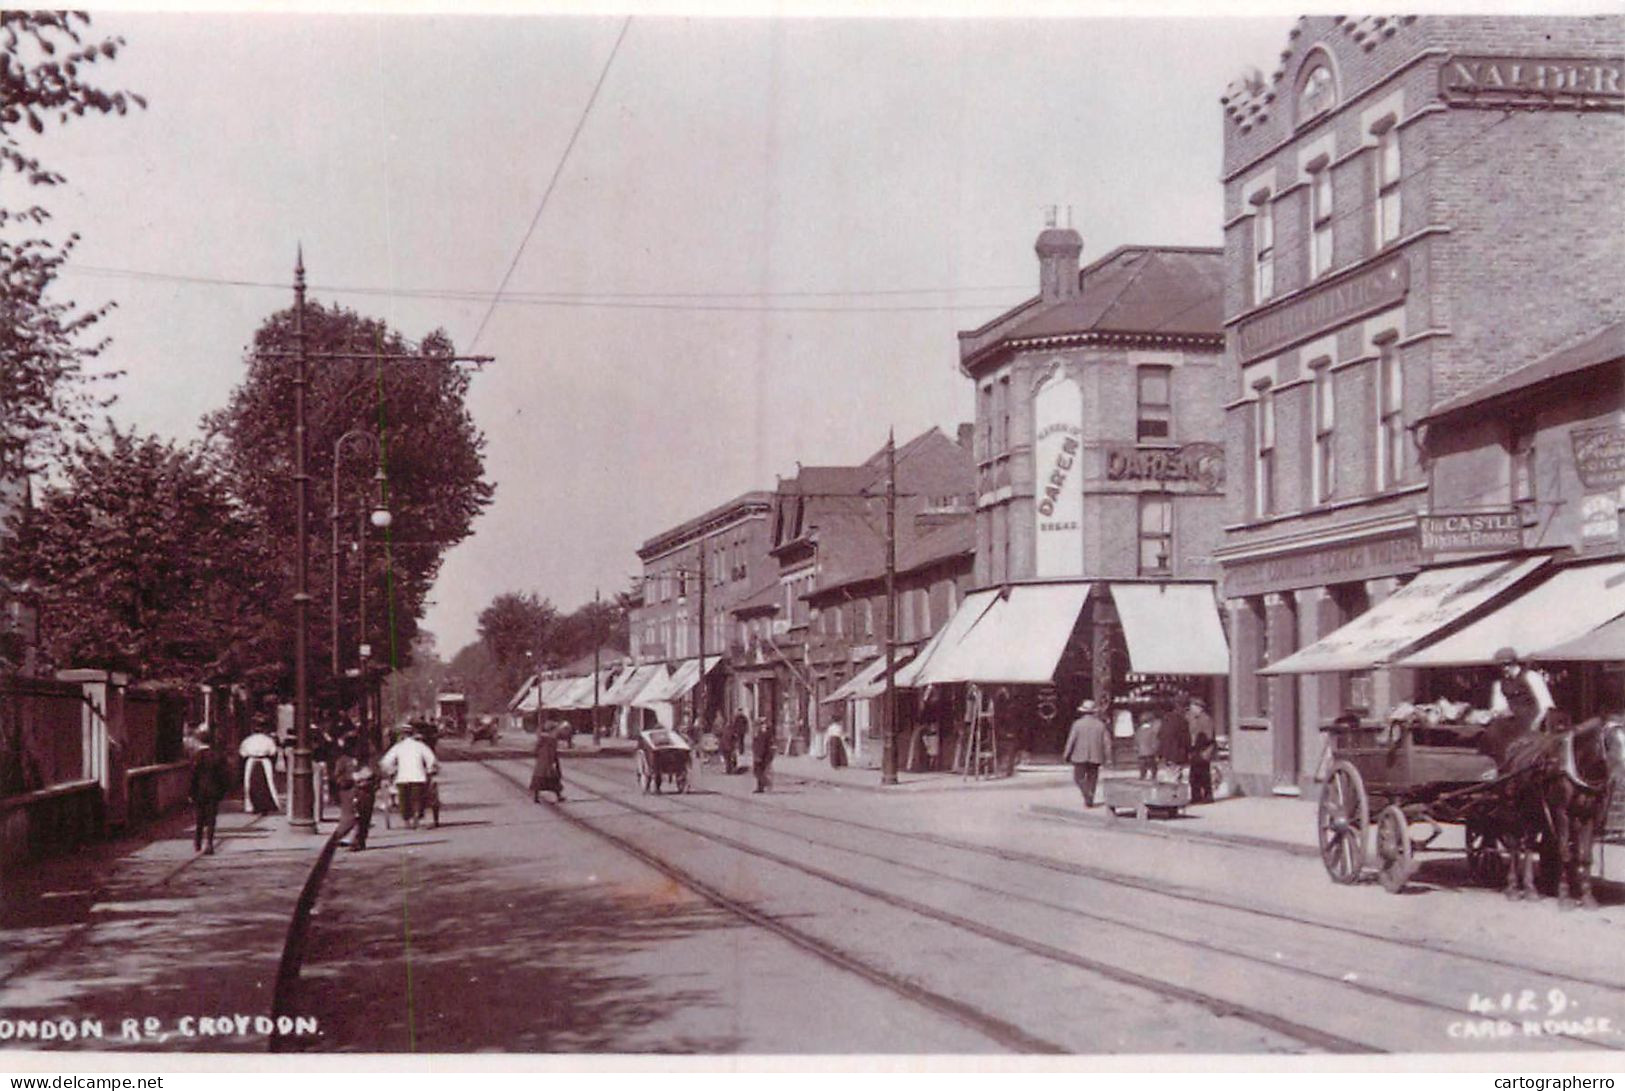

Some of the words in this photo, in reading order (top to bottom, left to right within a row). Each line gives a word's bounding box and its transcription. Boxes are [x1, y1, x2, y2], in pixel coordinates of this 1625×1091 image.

[1038, 437, 1079, 517] DAREN
[1107, 450, 1196, 480] DAREN
[1040, 522, 1077, 531] BREAD
[1446, 514, 1518, 532] CASTLE
